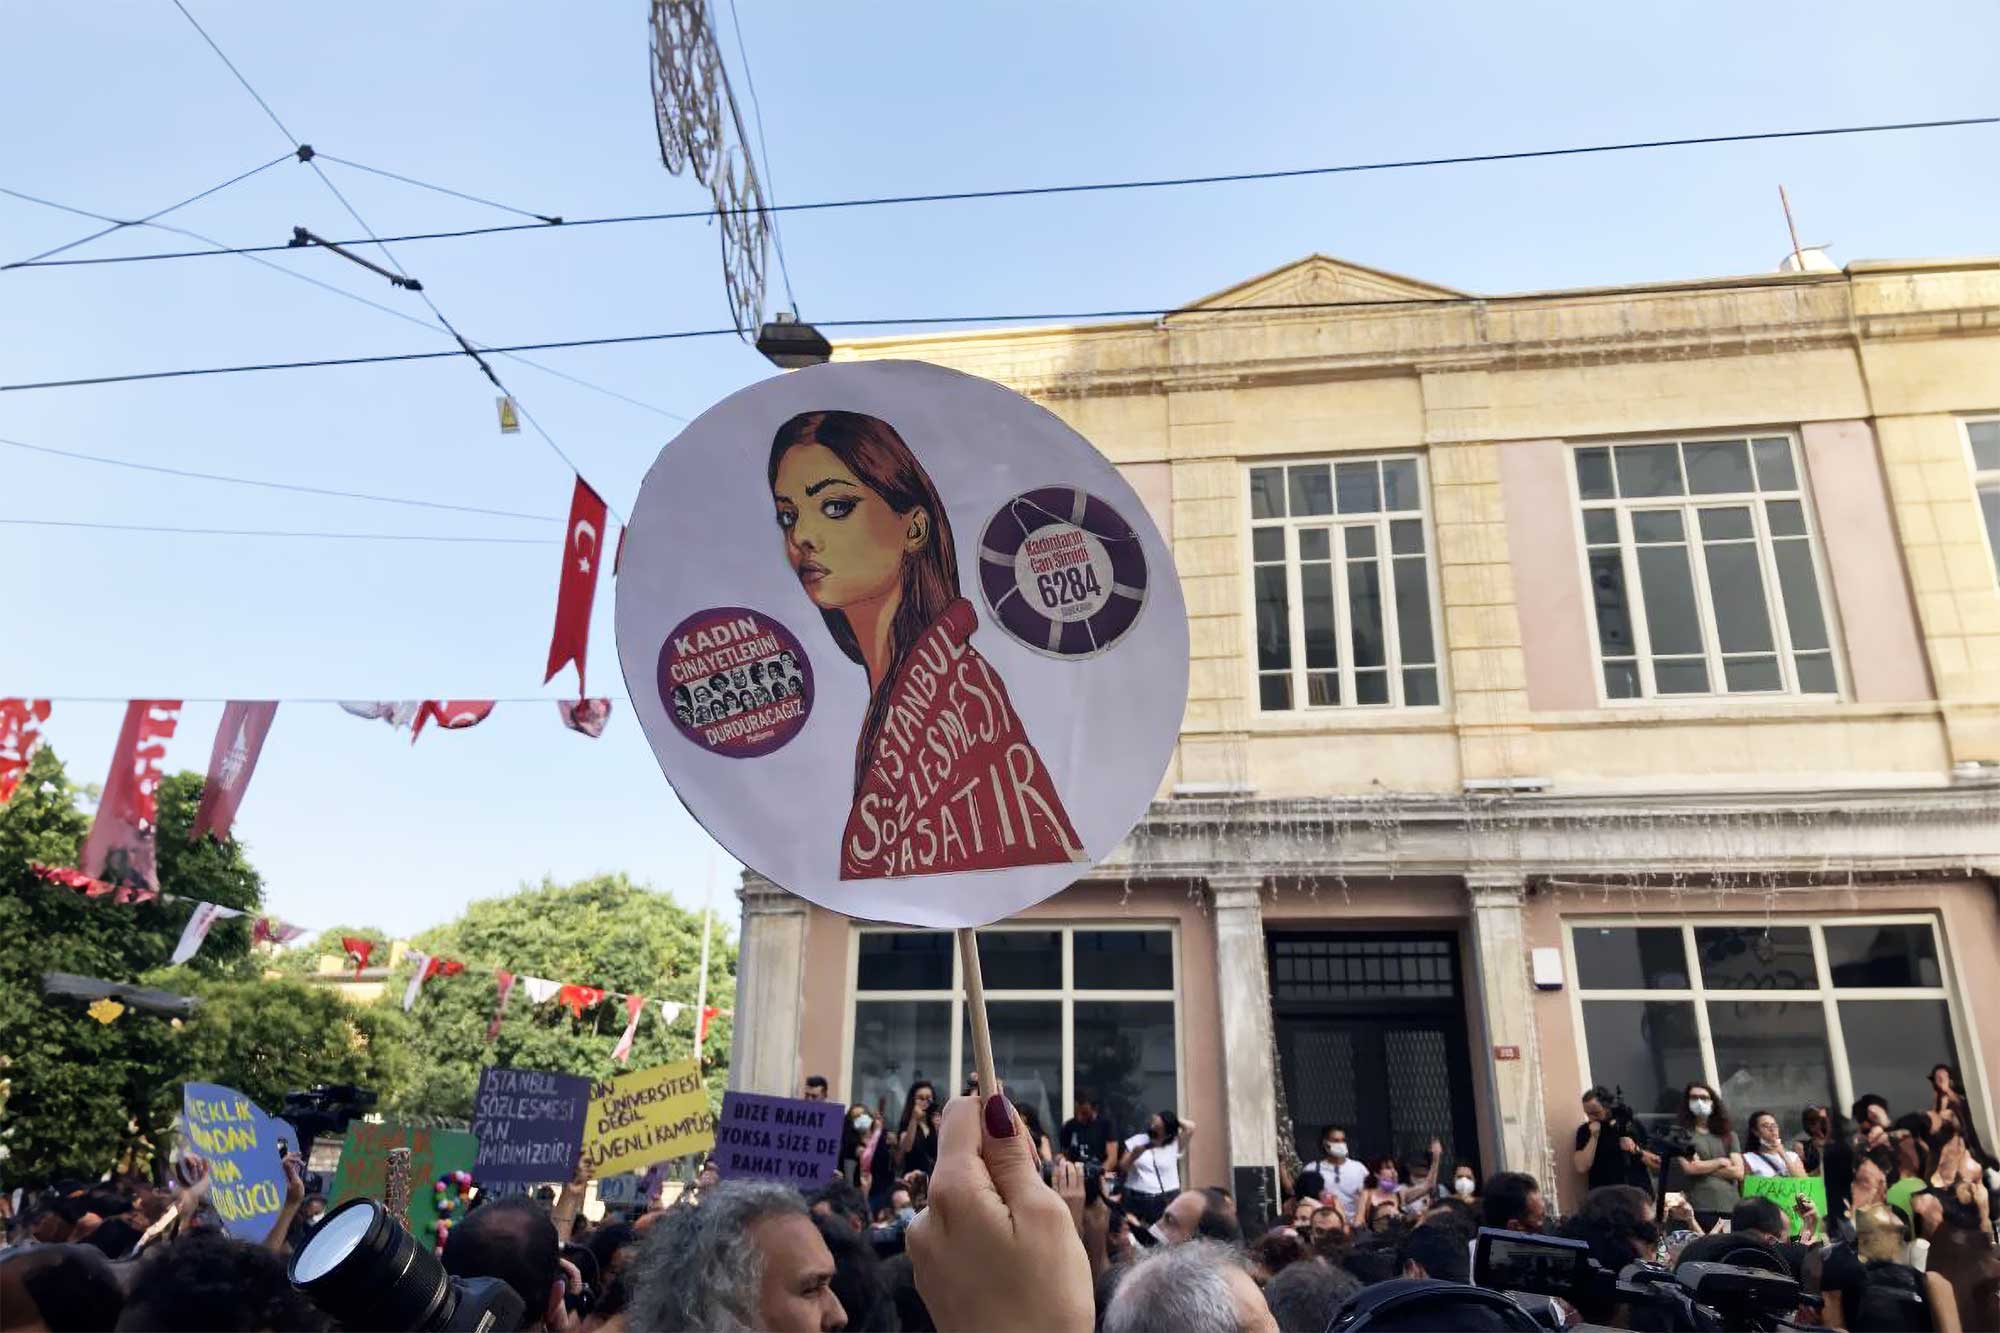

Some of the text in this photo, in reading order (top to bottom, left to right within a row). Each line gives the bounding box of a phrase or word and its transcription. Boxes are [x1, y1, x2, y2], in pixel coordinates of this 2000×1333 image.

[1037, 563, 1102, 608] 6284
[674, 616, 760, 657] KADIN
[775, 1106, 826, 1129] RAHAT
[588, 1124, 653, 1167] ÜVENLİ
[721, 1126, 772, 1148] YOKSA
[817, 1137, 838, 1157] DE
[731, 1153, 820, 1180] RAHAT YOK
